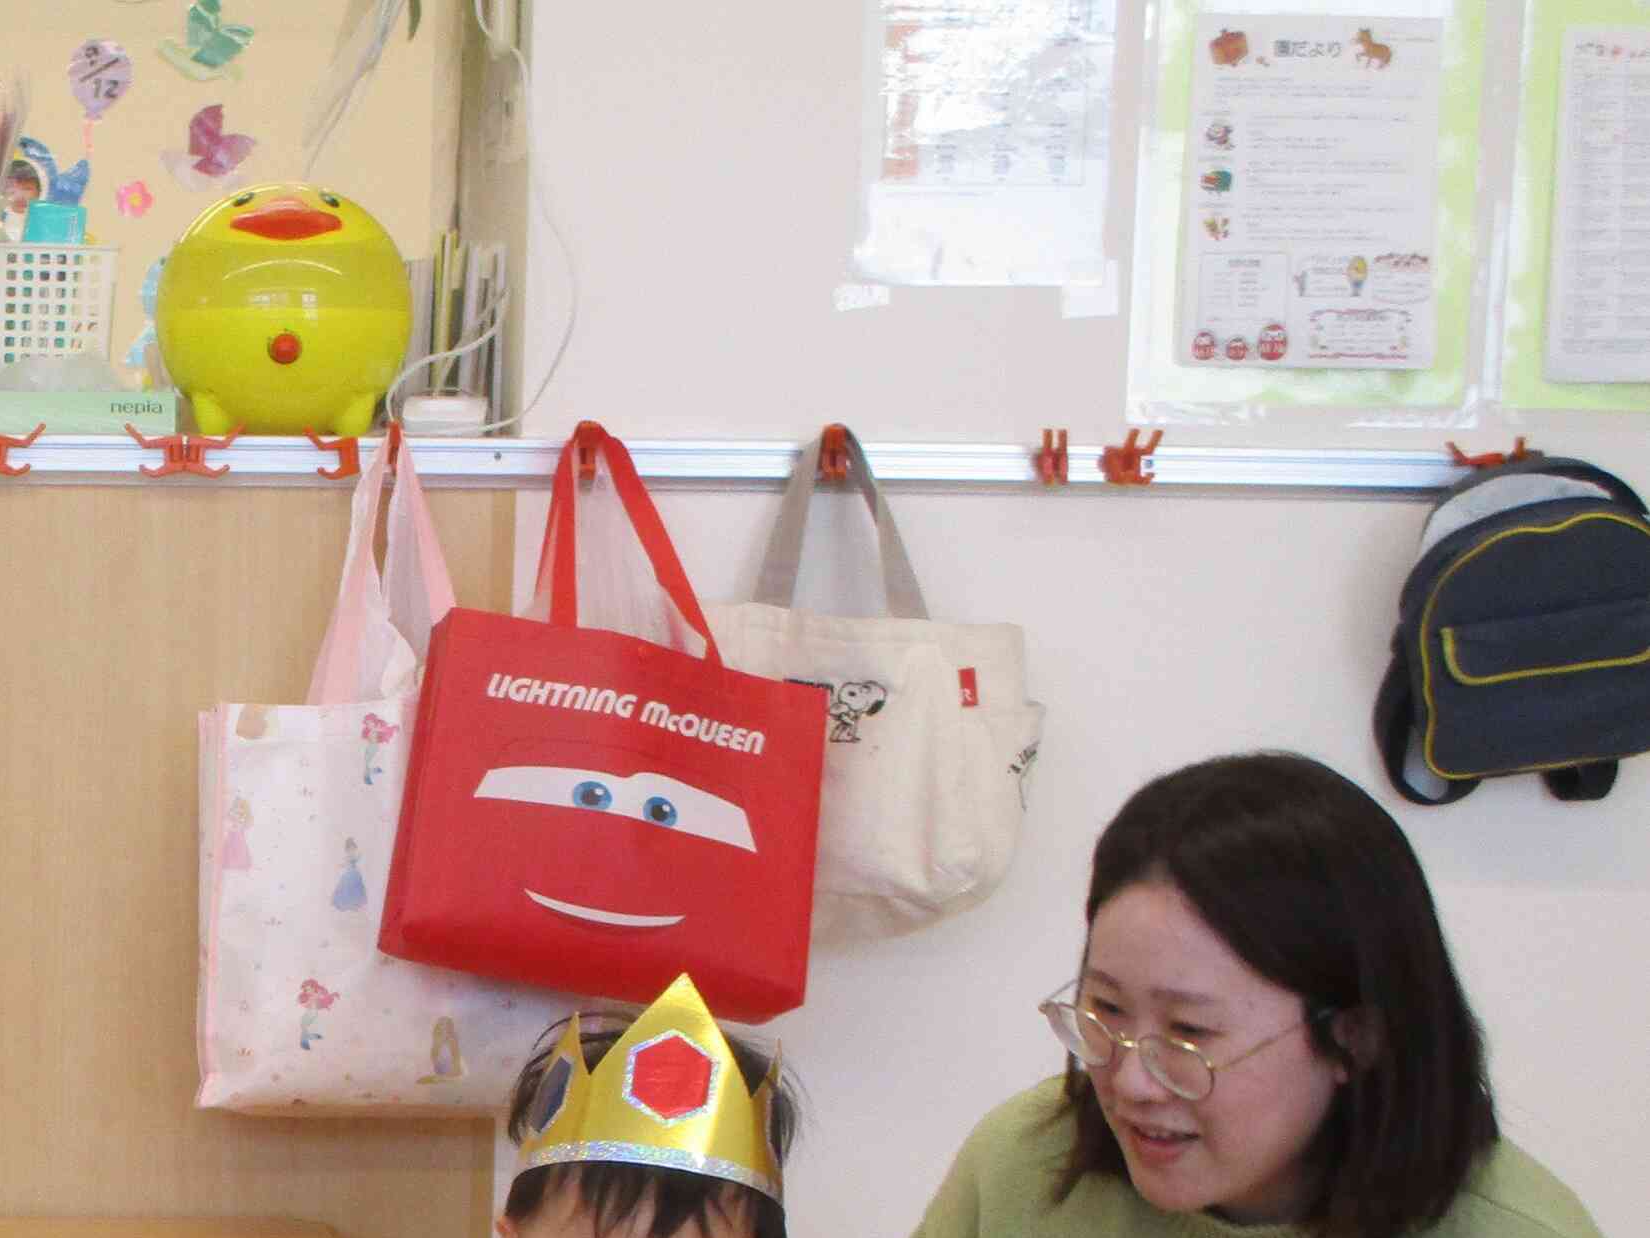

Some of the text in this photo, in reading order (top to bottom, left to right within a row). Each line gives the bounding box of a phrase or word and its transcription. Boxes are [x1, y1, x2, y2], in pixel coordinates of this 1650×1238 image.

[1273, 40, 1343, 58] 園だより
[110, 400, 163, 414] nepia
[487, 673, 766, 755] LIGHTNING McQUEEN
